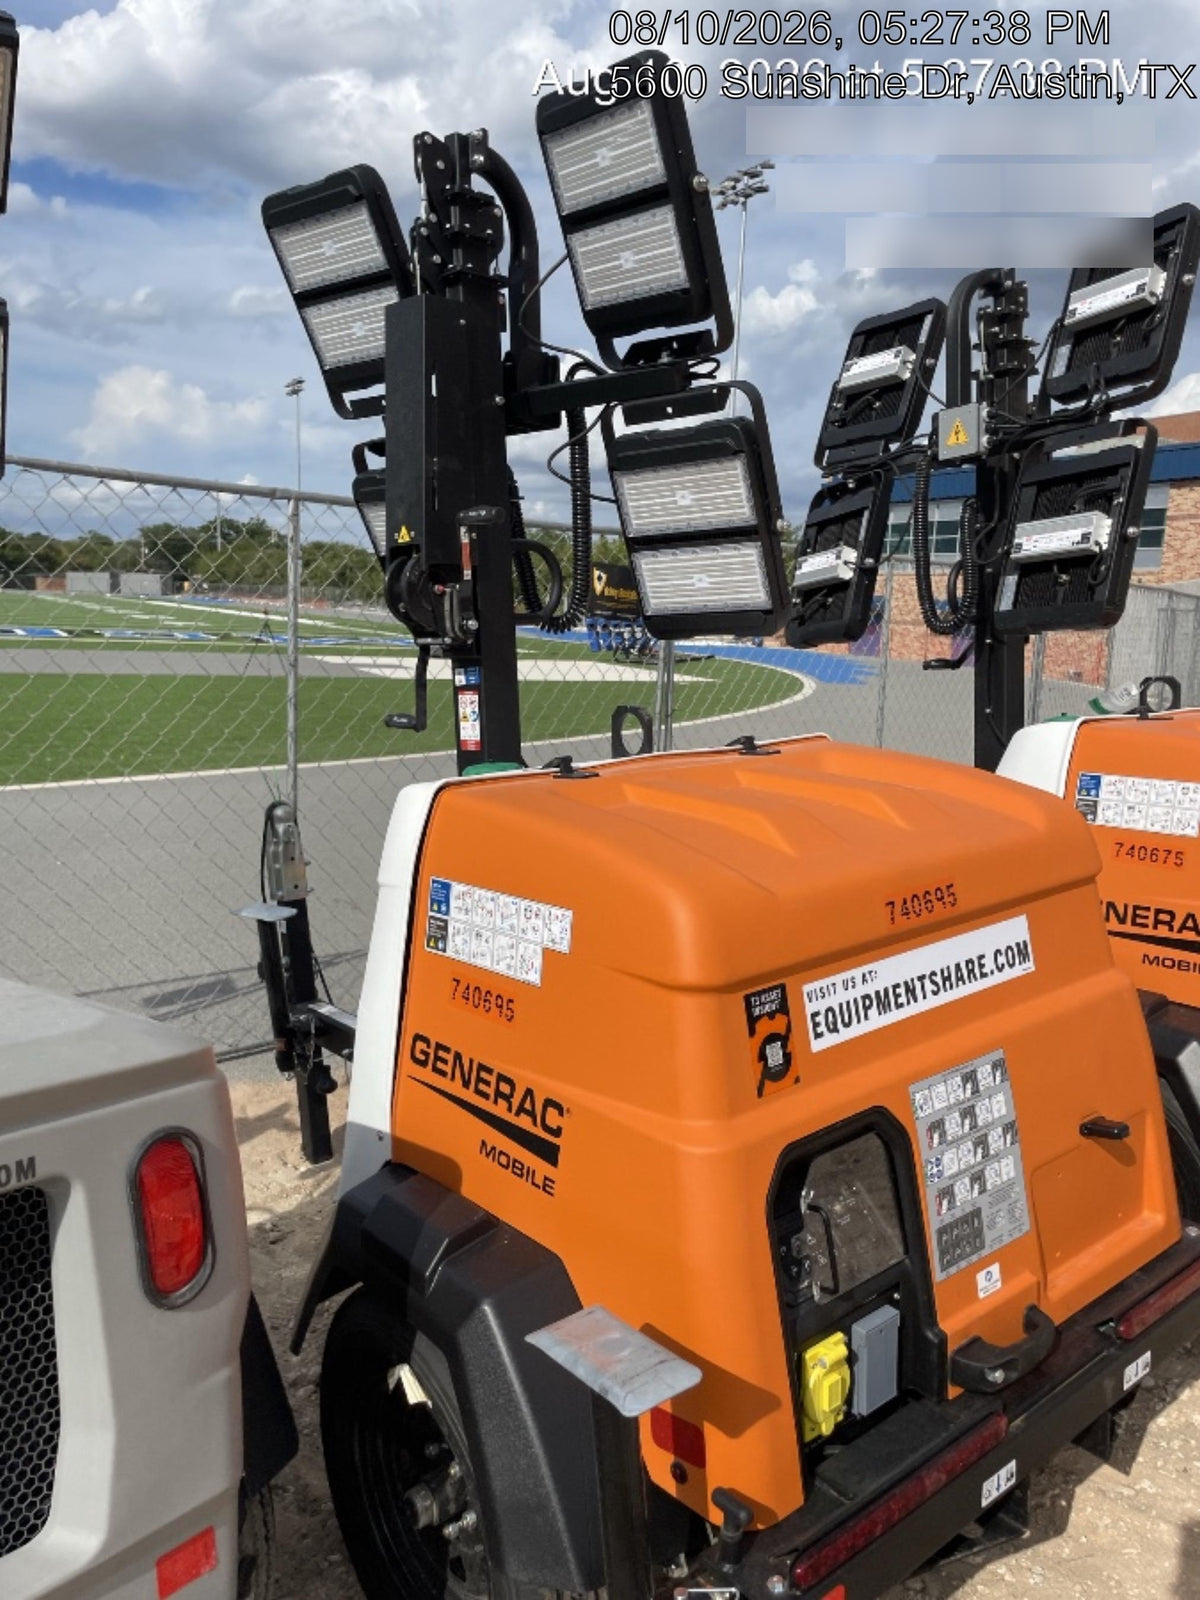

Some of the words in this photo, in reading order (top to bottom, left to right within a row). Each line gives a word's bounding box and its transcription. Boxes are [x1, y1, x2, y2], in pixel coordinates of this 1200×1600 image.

[1114, 842, 1185, 868] 740675
[885, 883, 957, 924] 740695
[1100, 900, 1200, 937] NERA
[1142, 953, 1200, 975] MOBI
[451, 977, 516, 1022] 740695
[806, 982, 837, 1003] VISIT
[842, 975, 857, 991] US
[861, 969, 878, 986] AT:
[810, 940, 1031, 1040] EQUIPMENTSHARE.COM
[409, 1032, 565, 1138] GENERAC
[479, 1139, 556, 1196] MOBILE
